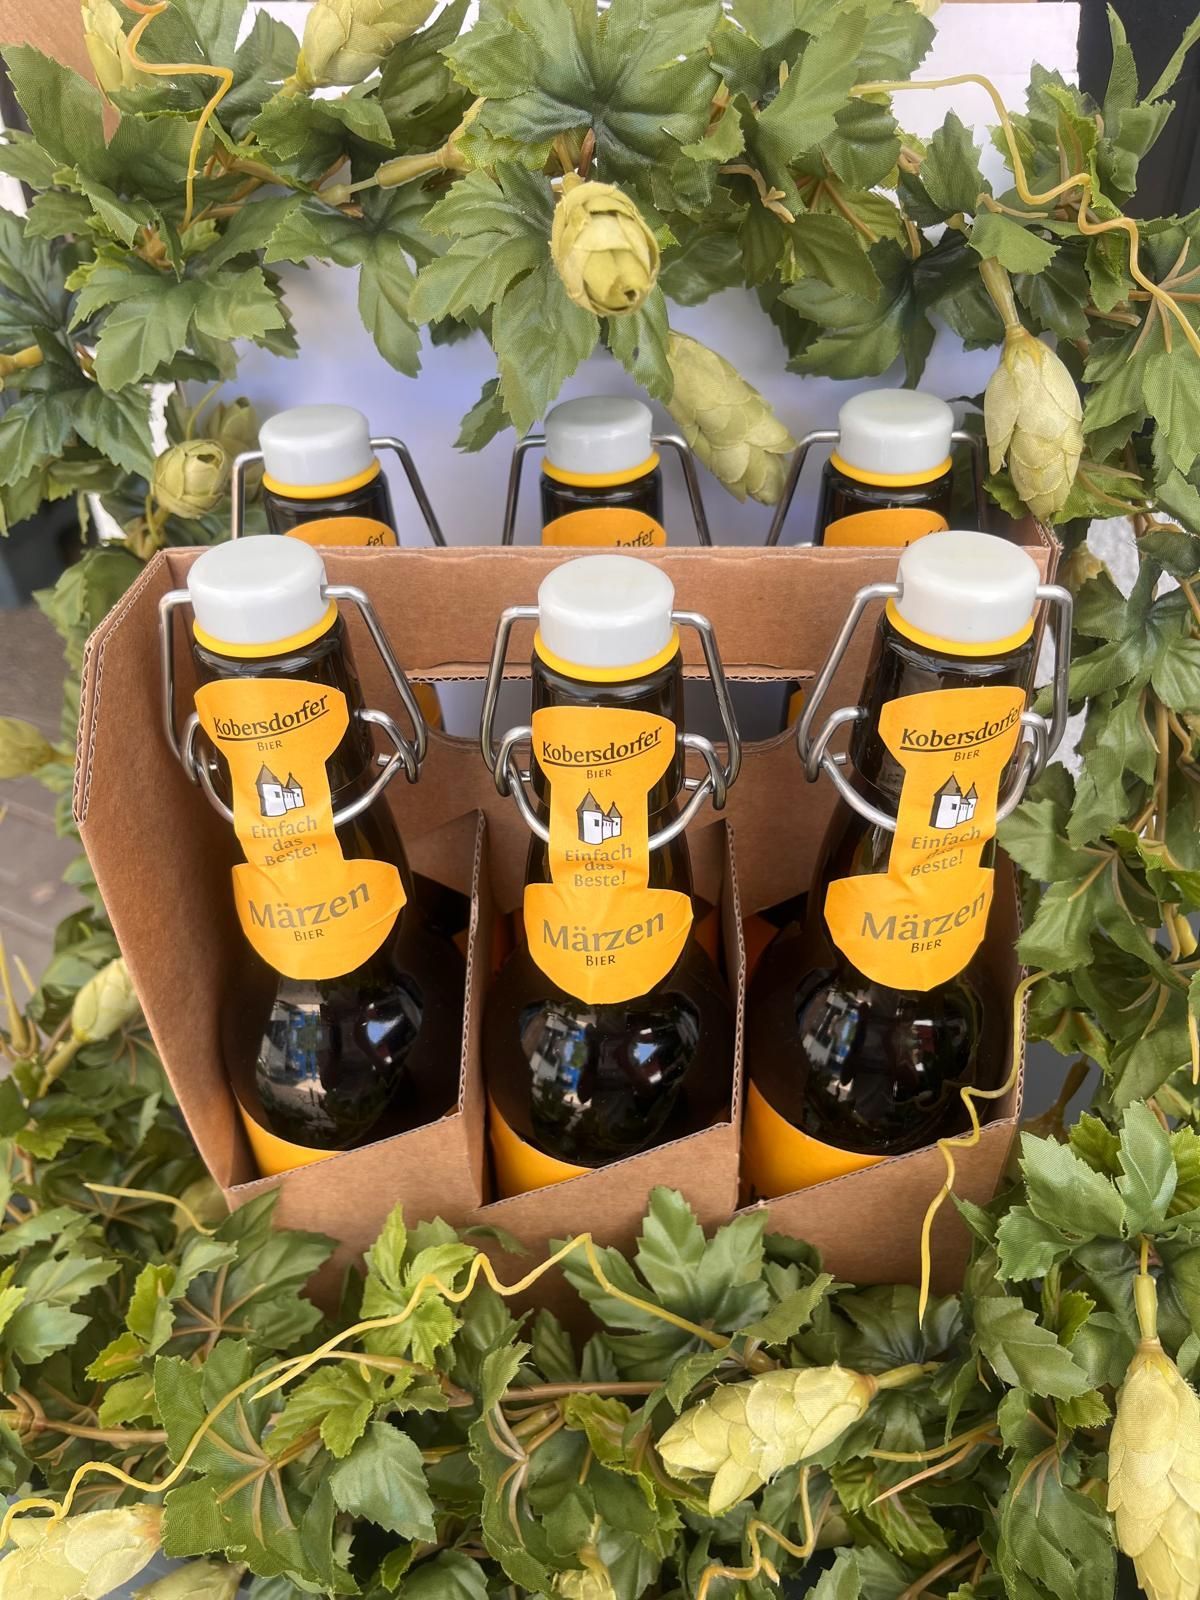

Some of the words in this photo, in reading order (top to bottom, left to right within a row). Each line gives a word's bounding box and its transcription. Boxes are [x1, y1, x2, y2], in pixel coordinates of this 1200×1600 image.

[213, 693, 330, 737] Kobersdorfer
[256, 739, 284, 752] BIER
[542, 725, 662, 764] Kobersdorfer
[953, 749, 981, 762] BIER
[586, 768, 613, 779] BIER
[251, 815, 318, 840] Einfach
[911, 826, 982, 850] Einfach
[264, 842, 319, 868] Beste!
[272, 837, 304, 853] das
[564, 844, 633, 862] Einfach
[910, 848, 965, 877] Beste!
[573, 870, 627, 888] Beste!
[248, 882, 371, 929] Märzen
[860, 891, 987, 942] Märzen
[293, 928, 326, 943] BIER
[542, 912, 665, 953] Märzen
[911, 939, 943, 954] BIER
[585, 955, 617, 968] BIER
